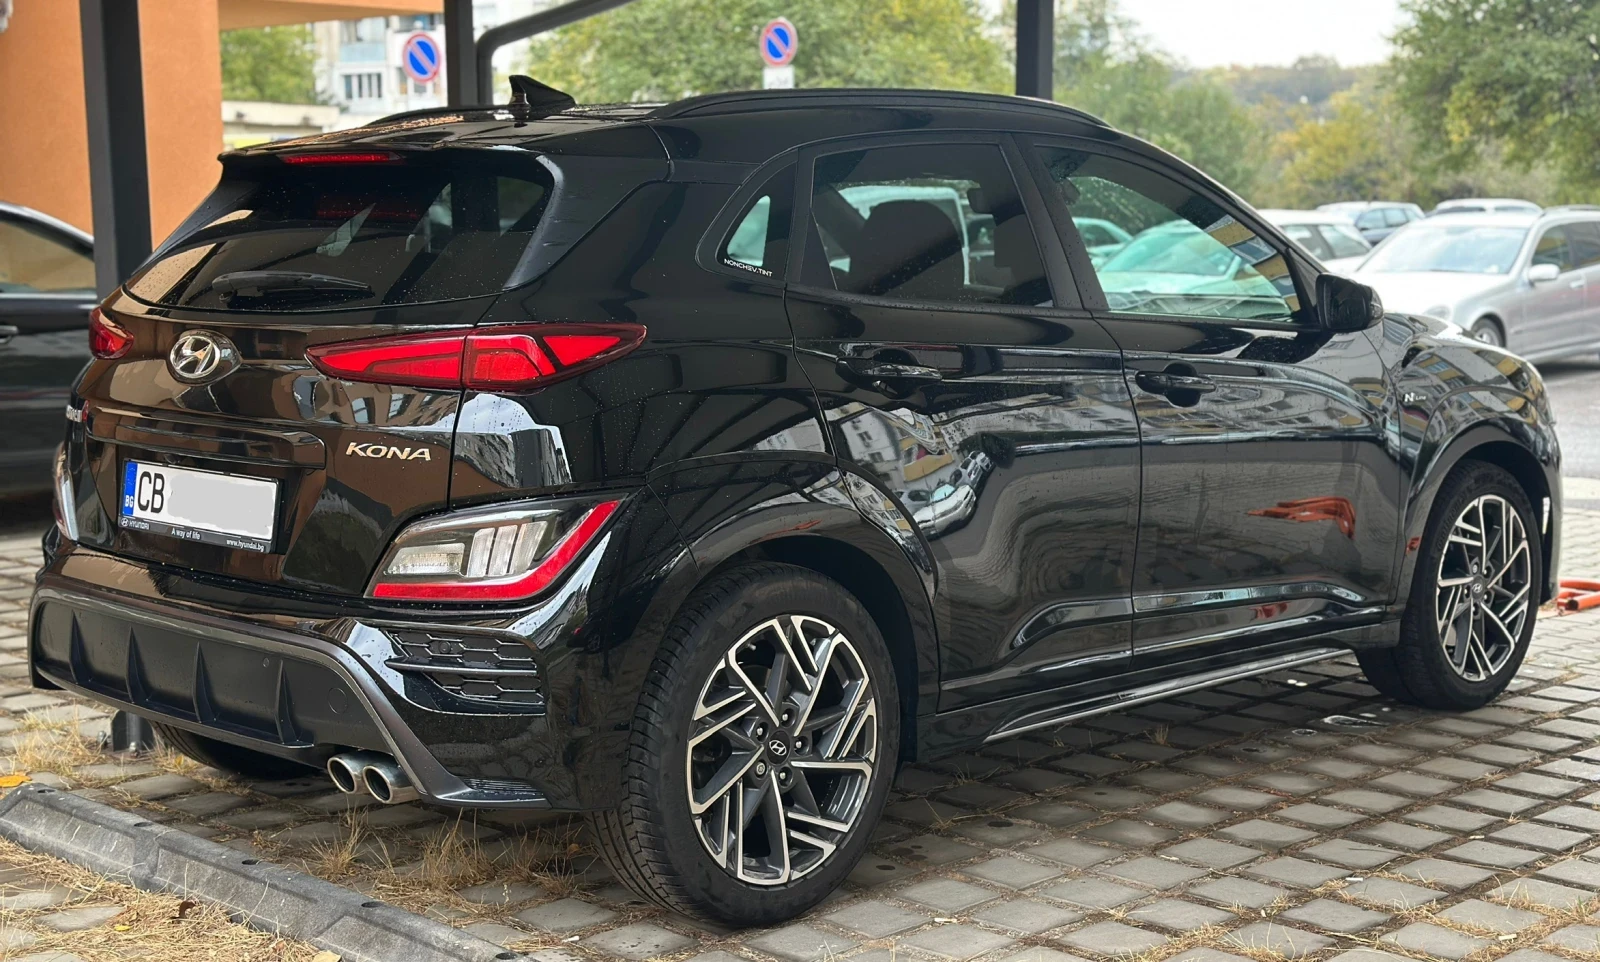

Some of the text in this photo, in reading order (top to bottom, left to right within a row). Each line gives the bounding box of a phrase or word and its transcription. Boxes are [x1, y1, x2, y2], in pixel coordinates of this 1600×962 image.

[724, 258, 773, 276] NONCHEV.TINT
[1405, 392, 1415, 402] N
[345, 442, 431, 461] KONA
[137, 471, 164, 513] CB
[125, 495, 134, 508] BG
[171, 527, 176, 535] A
[176, 530, 186, 538] way
[192, 531, 200, 540] life
[226, 539, 264, 552] www.hyundai.bg
